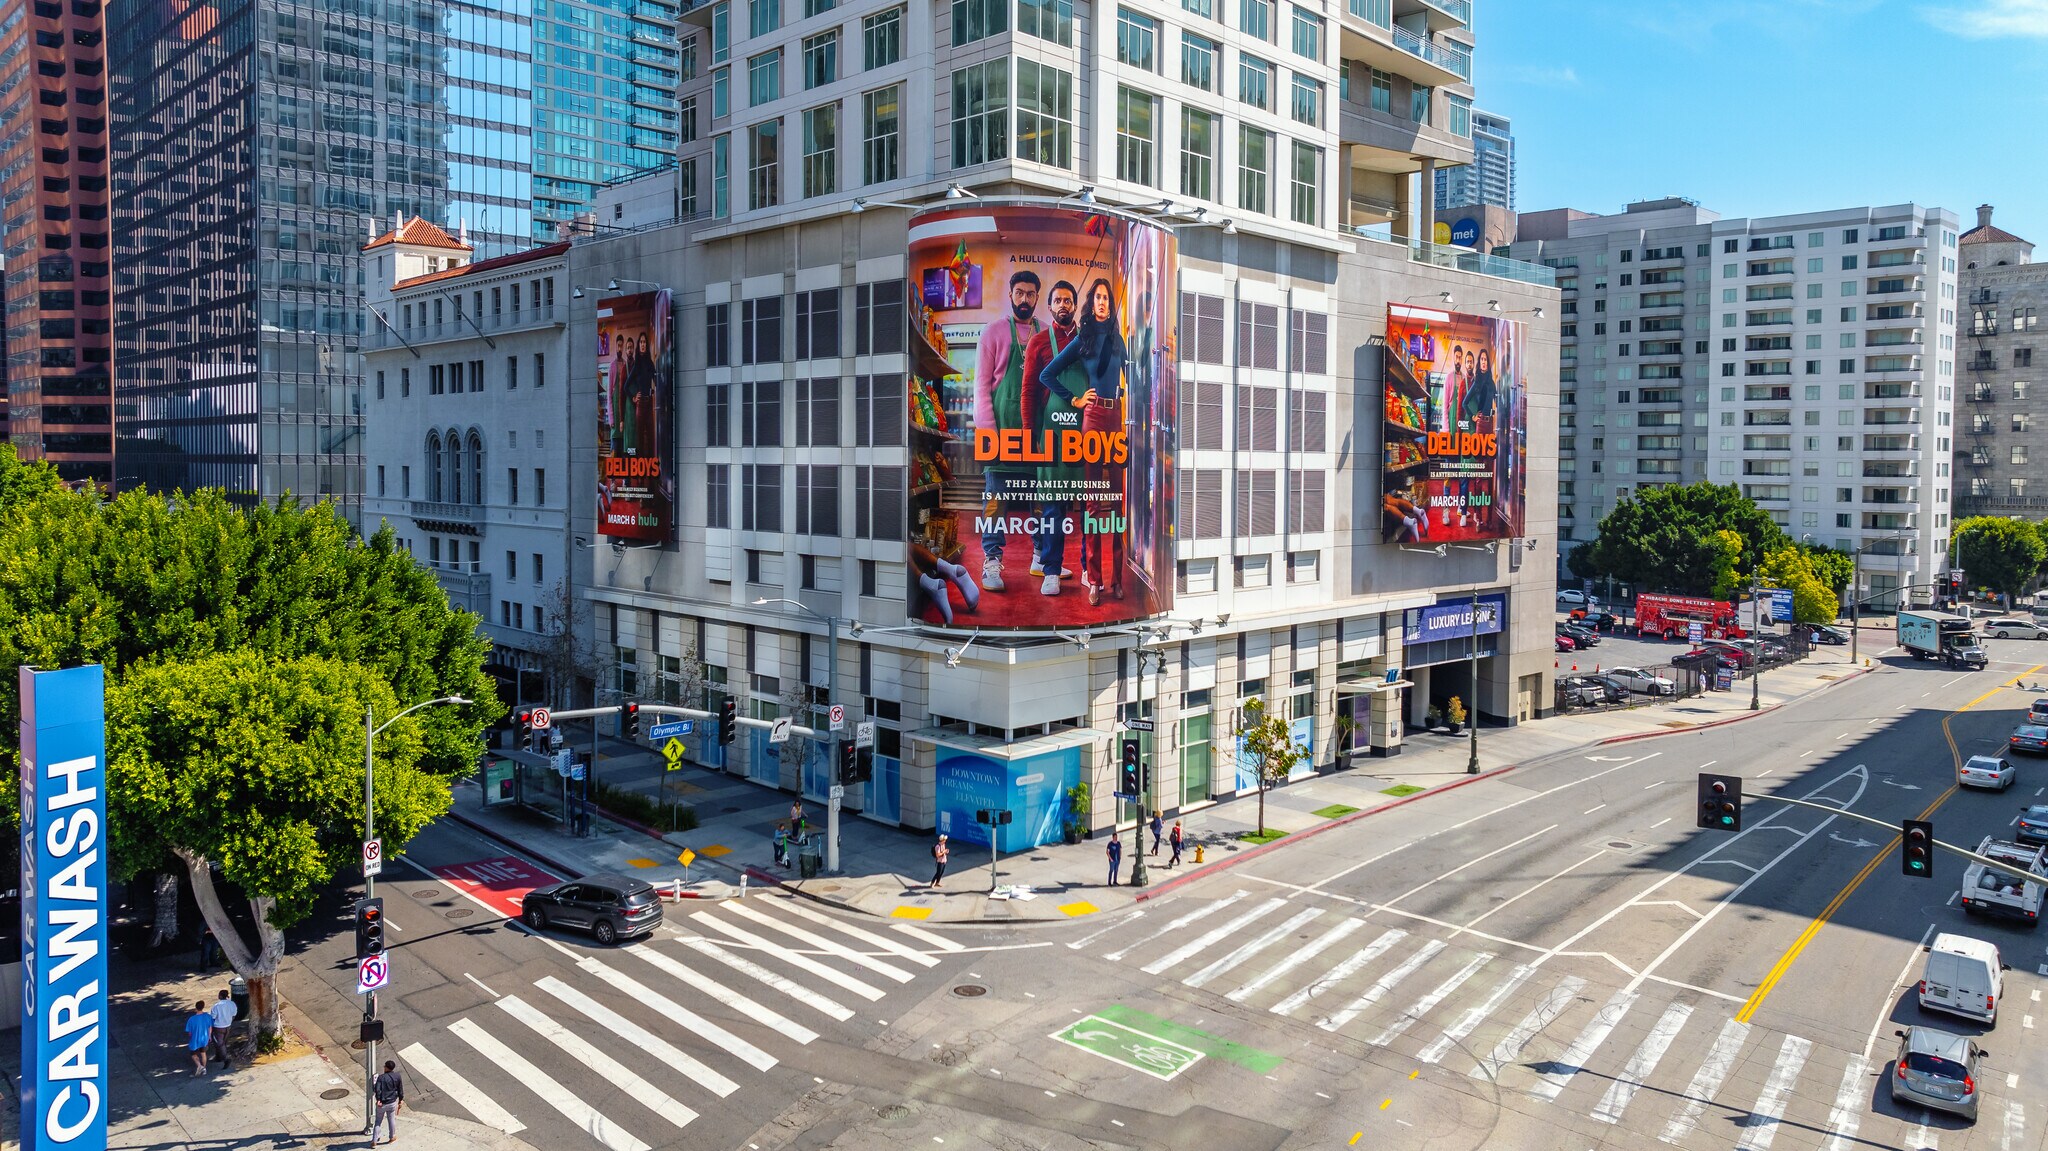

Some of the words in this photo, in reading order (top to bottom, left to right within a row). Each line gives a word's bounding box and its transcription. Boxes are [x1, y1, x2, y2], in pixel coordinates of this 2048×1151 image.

[1454, 228, 1474, 240] met
[1019, 255, 1043, 263] HULU
[1046, 256, 1084, 266] ORIGINAL
[1086, 260, 1110, 270] COMEDY
[1052, 412, 1077, 422] ONYX
[974, 428, 1054, 462] DELI
[1062, 430, 1128, 464] BOYS
[1428, 431, 1459, 455] DELI
[1462, 432, 1497, 456] BOYS
[606, 458, 628, 477] DELI
[630, 457, 660, 477] BOYS
[1005, 479, 1028, 488] THE
[1030, 480, 1069, 488] FAMILY
[1071, 480, 1110, 489] BUSINESS
[982, 492, 992, 500] IS
[994, 492, 1053, 501] ANYTHING
[1055, 493, 1075, 501] BUT
[1076, 493, 1123, 501] CONVENIENT
[1431, 496, 1459, 507] MARCH
[1460, 496, 1465, 506] 6
[1468, 492, 1491, 506] hulu
[608, 514, 630, 525] MARCH
[631, 516, 636, 525] 6
[638, 512, 658, 526] hulu
[975, 516, 1054, 535] MARCH
[1062, 518, 1074, 535] 6
[1084, 511, 1127, 535] hulu
[1429, 614, 1460, 630] LUXURY
[654, 725, 680, 736] Olympic
[772, 733, 787, 741] ONLY
[952, 768, 1000, 786] DOWNTOWN
[24, 758, 34, 898] WASH
[46, 754, 98, 984] WASH
[444, 861, 530, 886] LANE
[25, 916, 34, 1017] CAR
[46, 978, 100, 1143] CAR
